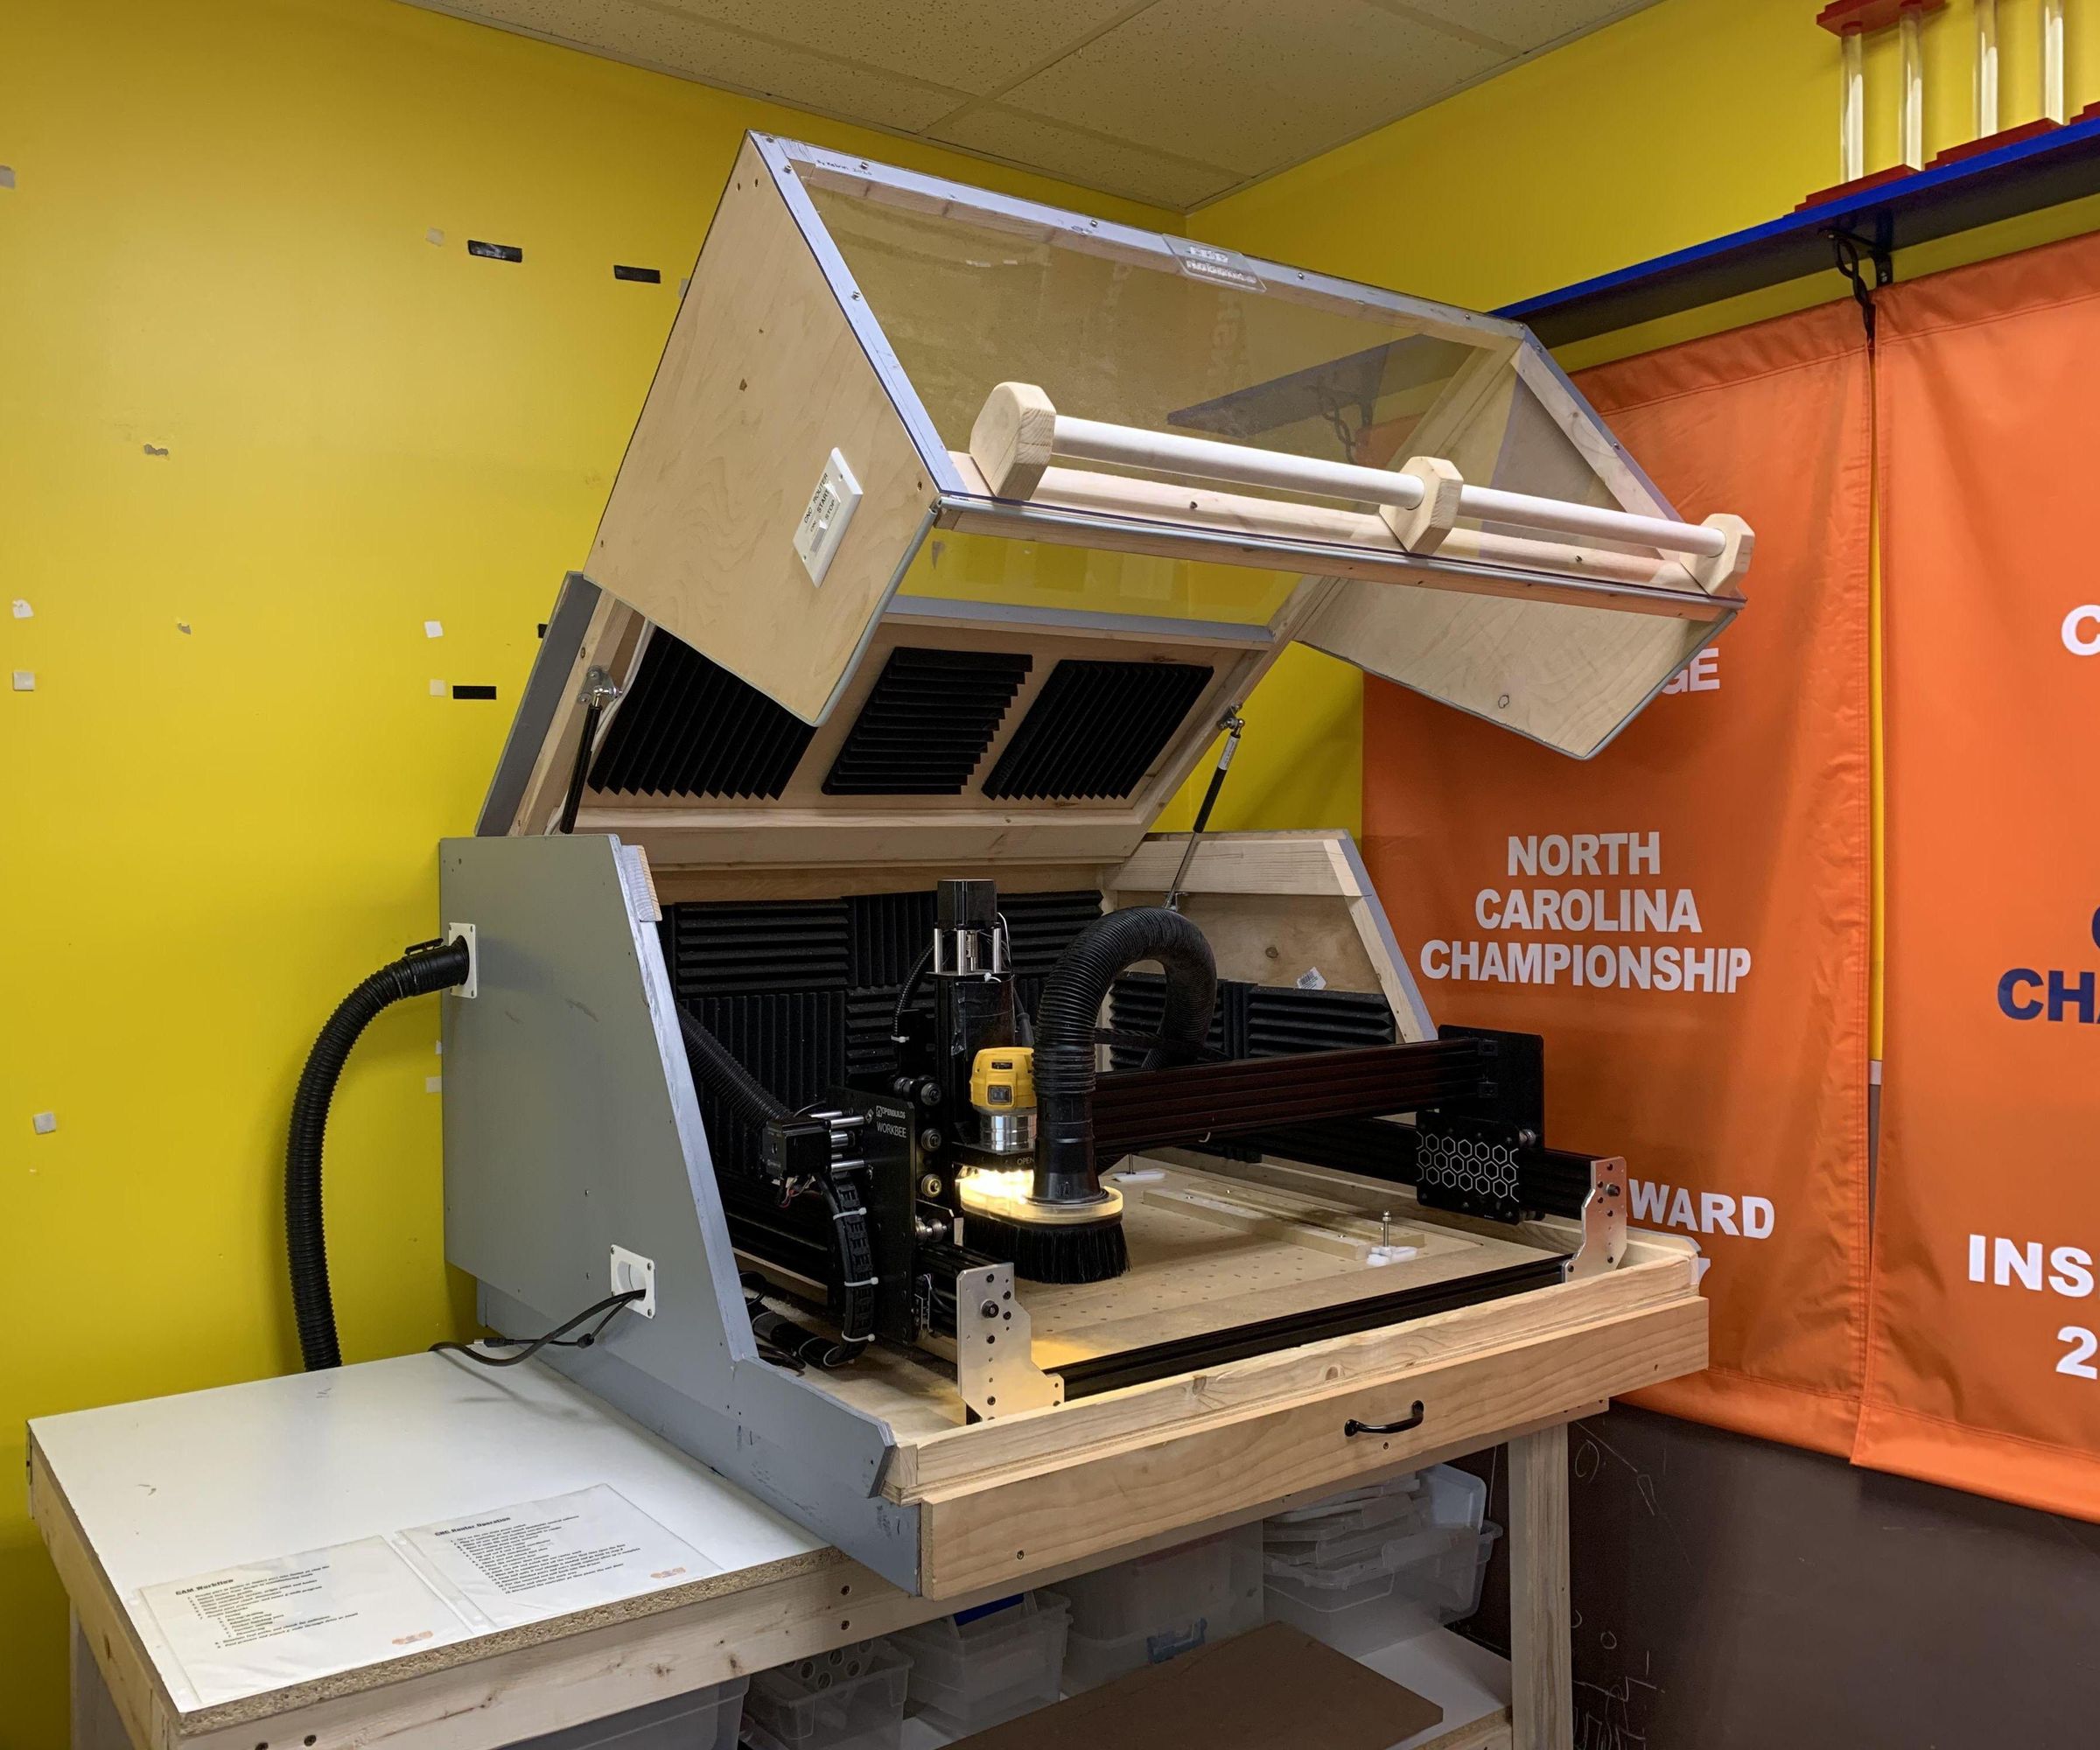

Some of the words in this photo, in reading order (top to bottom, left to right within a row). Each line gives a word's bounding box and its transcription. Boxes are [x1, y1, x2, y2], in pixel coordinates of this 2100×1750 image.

[813, 472, 829, 504] ROUTER
[816, 488, 830, 514] START
[1508, 831, 1661, 876] NORTH
[1475, 888, 1703, 933] CAROLINA
[1420, 939, 1752, 993] CHAMPIONSHIP
[1997, 968, 2100, 1024] CH
[877, 1121, 907, 1138] WORKBEE
[1627, 1179, 1775, 1240] WARD
